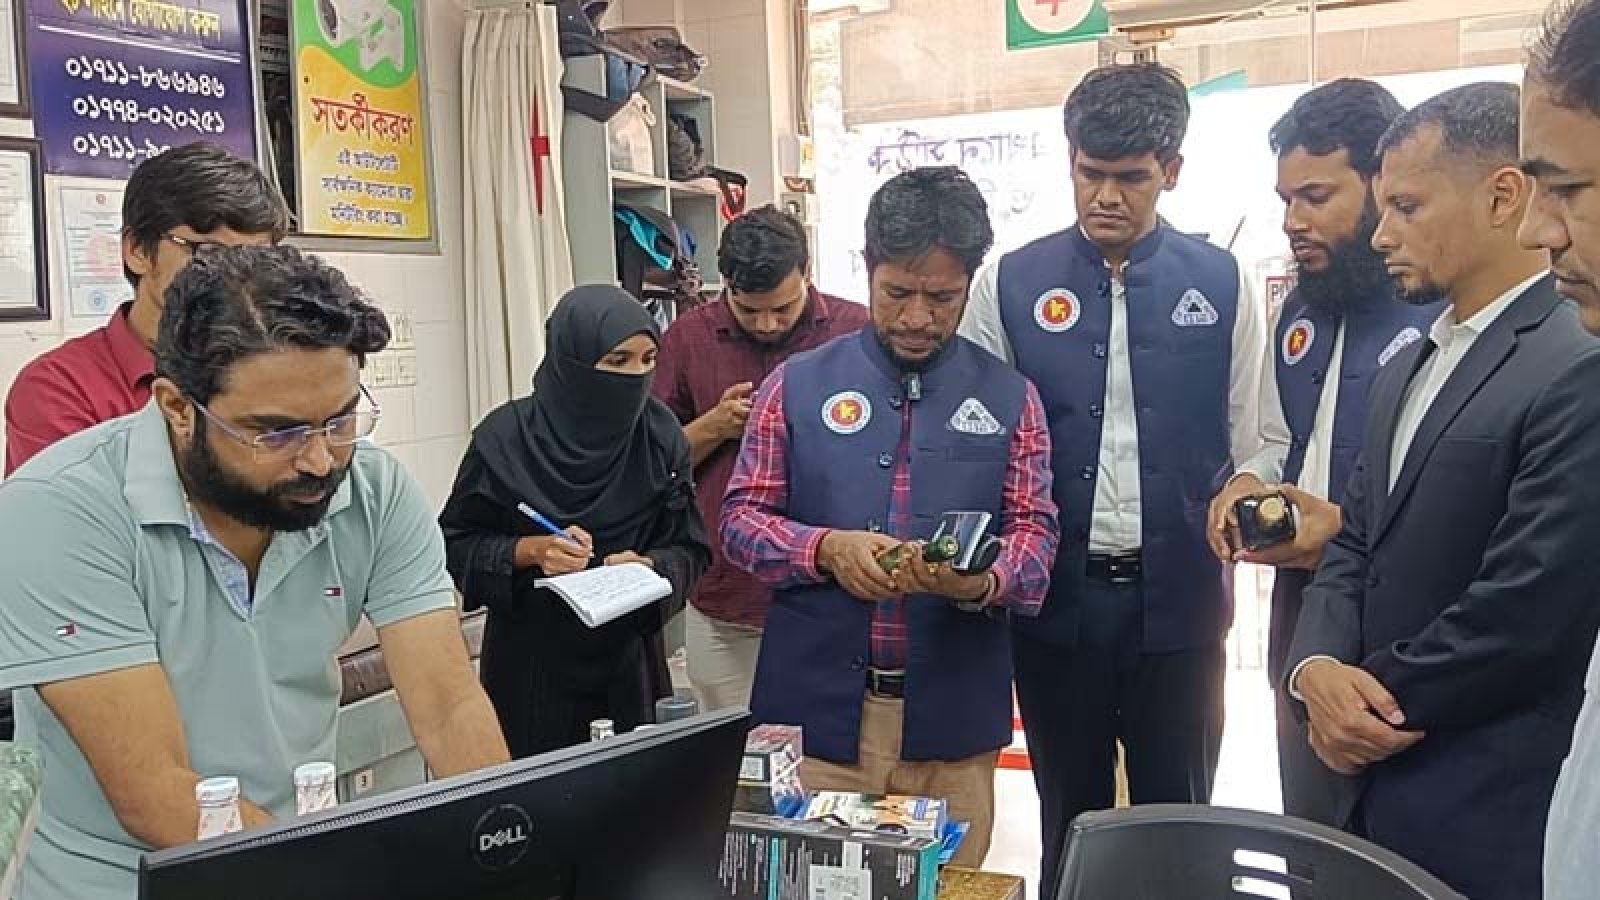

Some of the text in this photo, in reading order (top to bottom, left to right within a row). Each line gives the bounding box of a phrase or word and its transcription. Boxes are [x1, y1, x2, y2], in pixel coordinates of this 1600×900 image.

[65, 55, 225, 99] ০১৭১১-৮৬৬৯৪৬
[73, 94, 225, 133] ০১৭৭৪-০২০২৫১
[73, 132, 171, 160] ০১৭১১-৯
[479, 824, 527, 852] DELL
